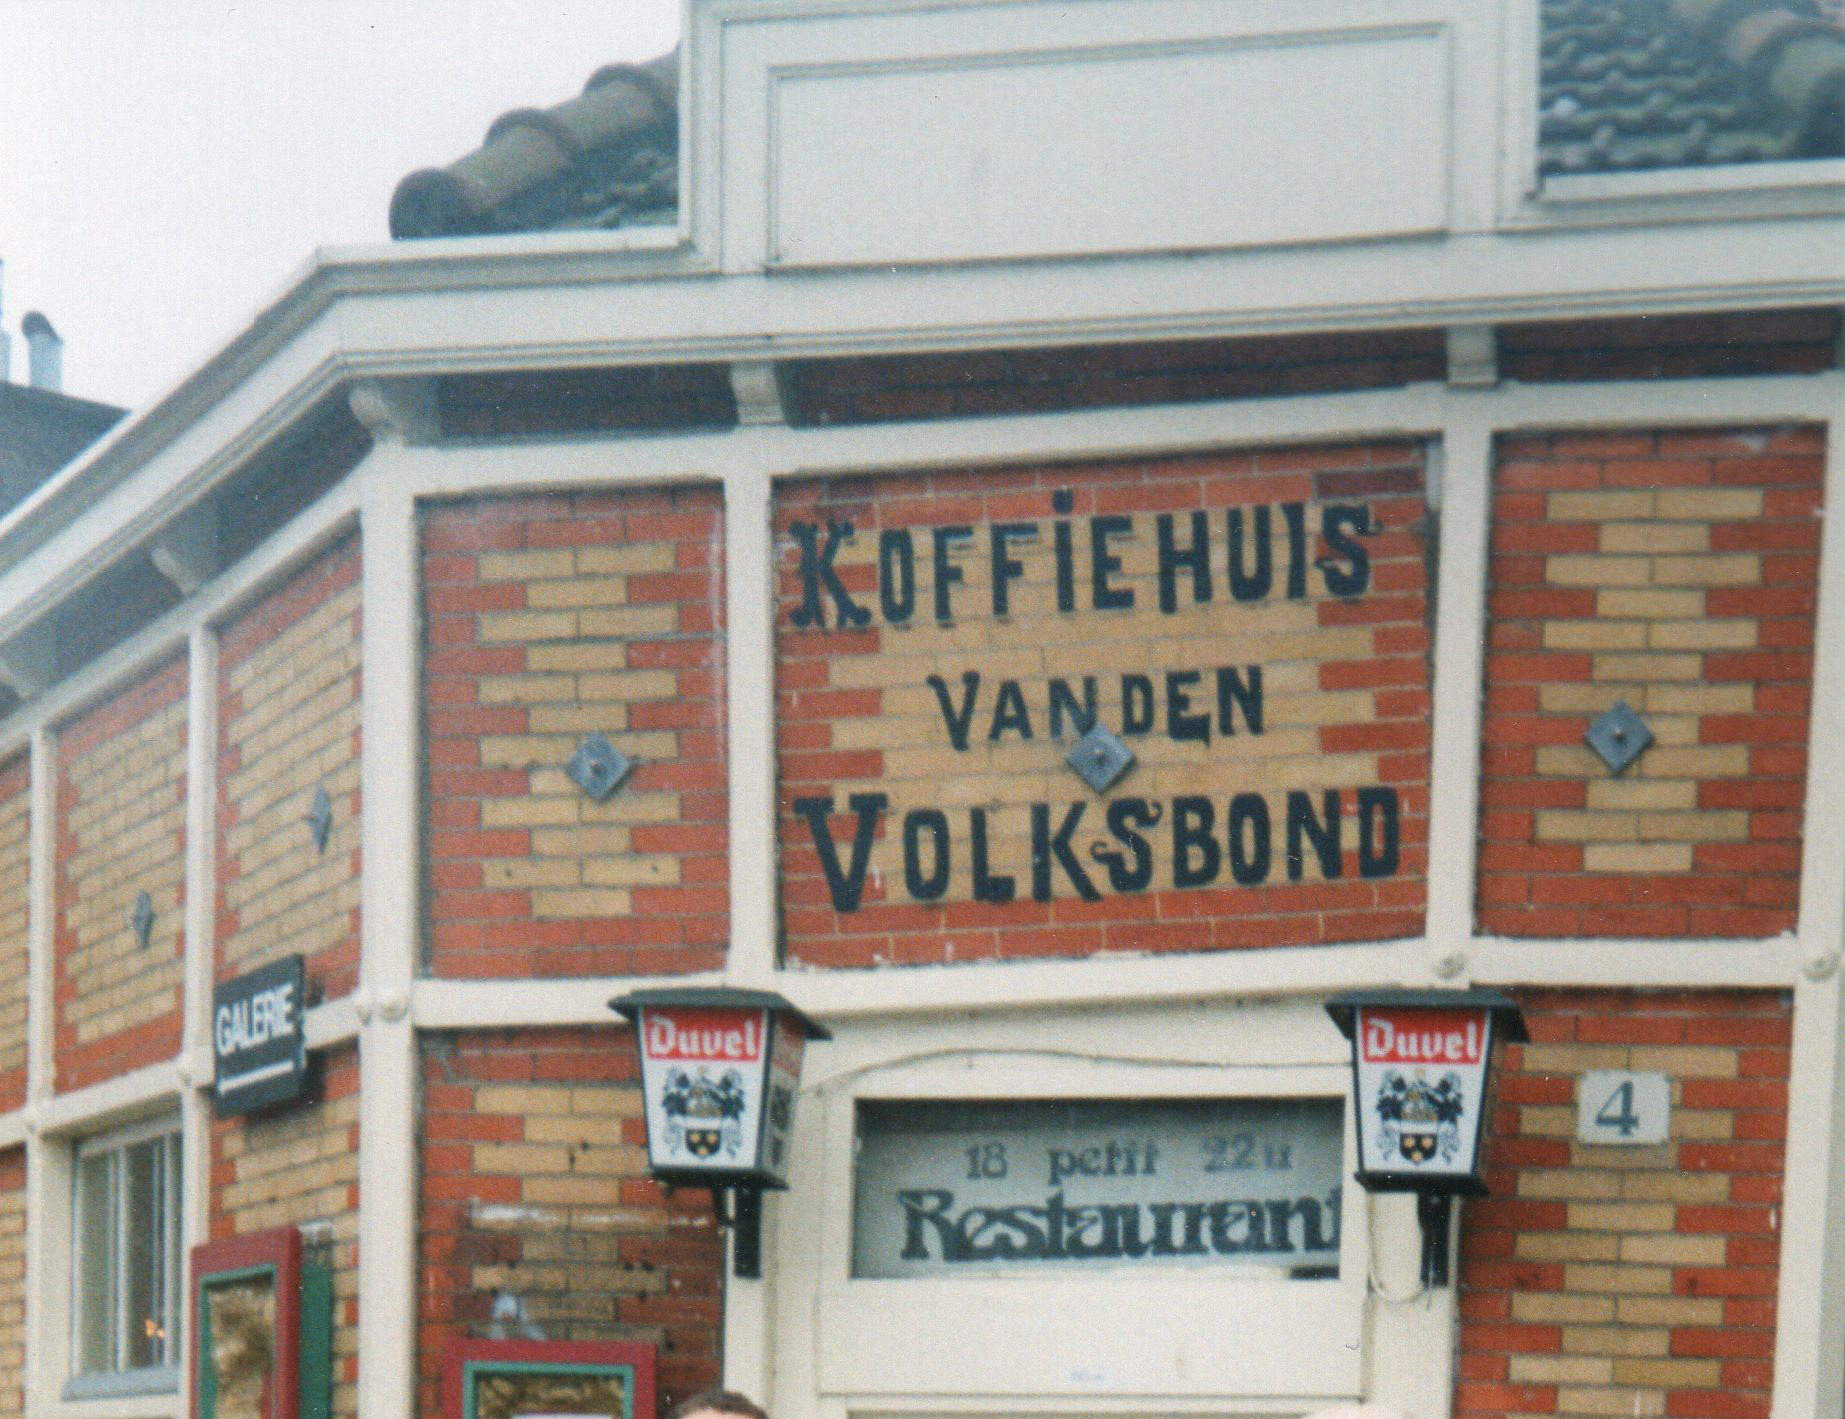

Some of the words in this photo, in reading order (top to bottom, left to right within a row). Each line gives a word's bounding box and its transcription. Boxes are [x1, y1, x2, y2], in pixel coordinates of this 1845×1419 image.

[793, 787, 1402, 914] VOLKSBOND
[217, 983, 294, 1056] GALERIE
[651, 1016, 756, 1056] Duvel
[1368, 1017, 1478, 1060] Duvel
[1595, 1081, 1639, 1136] 4
[965, 1143, 1008, 1181] 18
